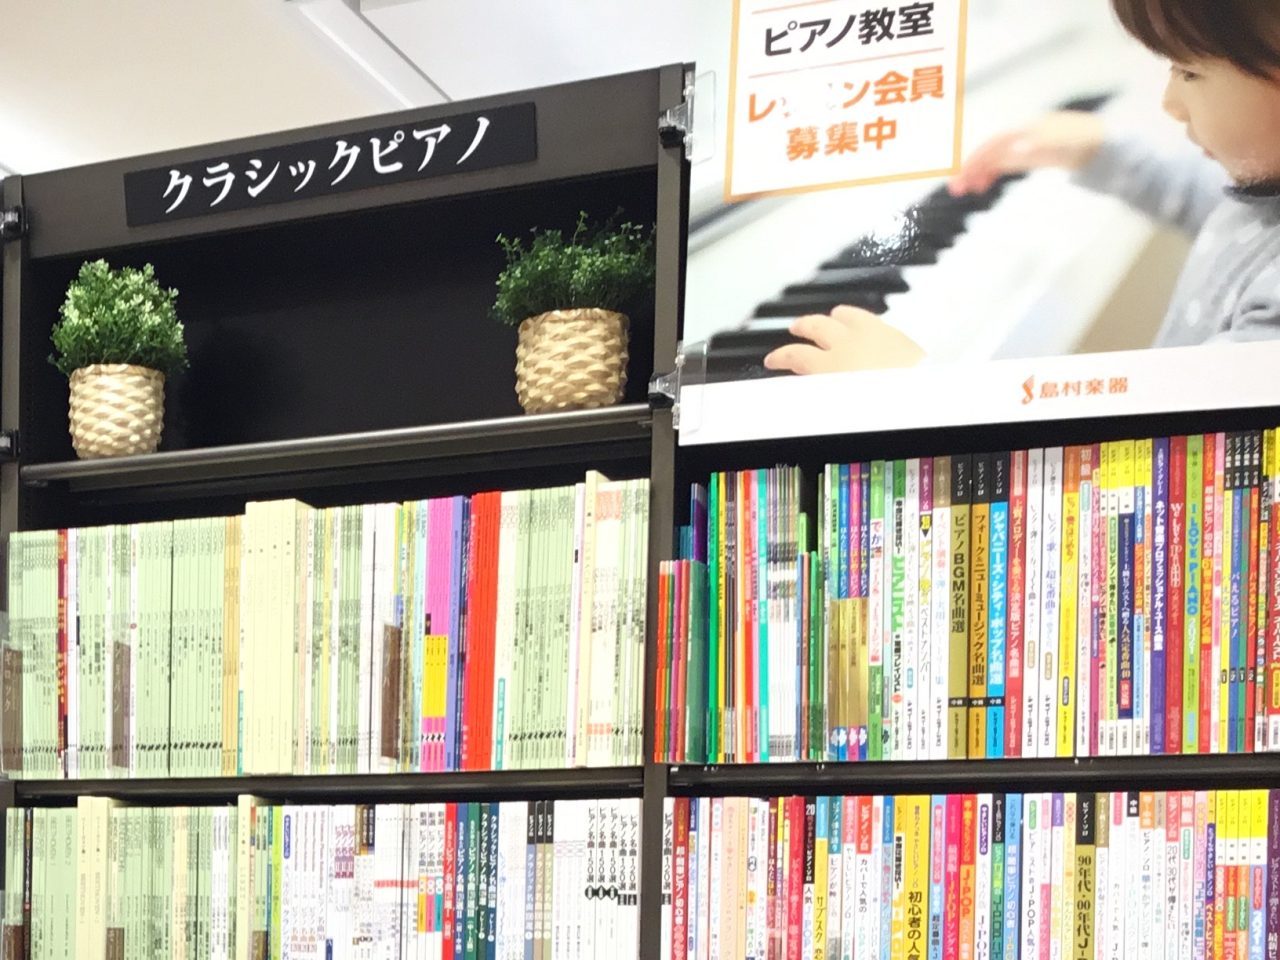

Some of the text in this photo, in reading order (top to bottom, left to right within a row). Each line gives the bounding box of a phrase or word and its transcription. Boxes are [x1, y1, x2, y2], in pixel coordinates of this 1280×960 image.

[763, 2, 936, 57] ピアノ教室
[162, 116, 491, 214] クラシックピアノ
[785, 117, 898, 161] 募集中
[1038, 377, 1130, 399] 島村楽器
[951, 512, 966, 634] ピアノBGM名曲選
